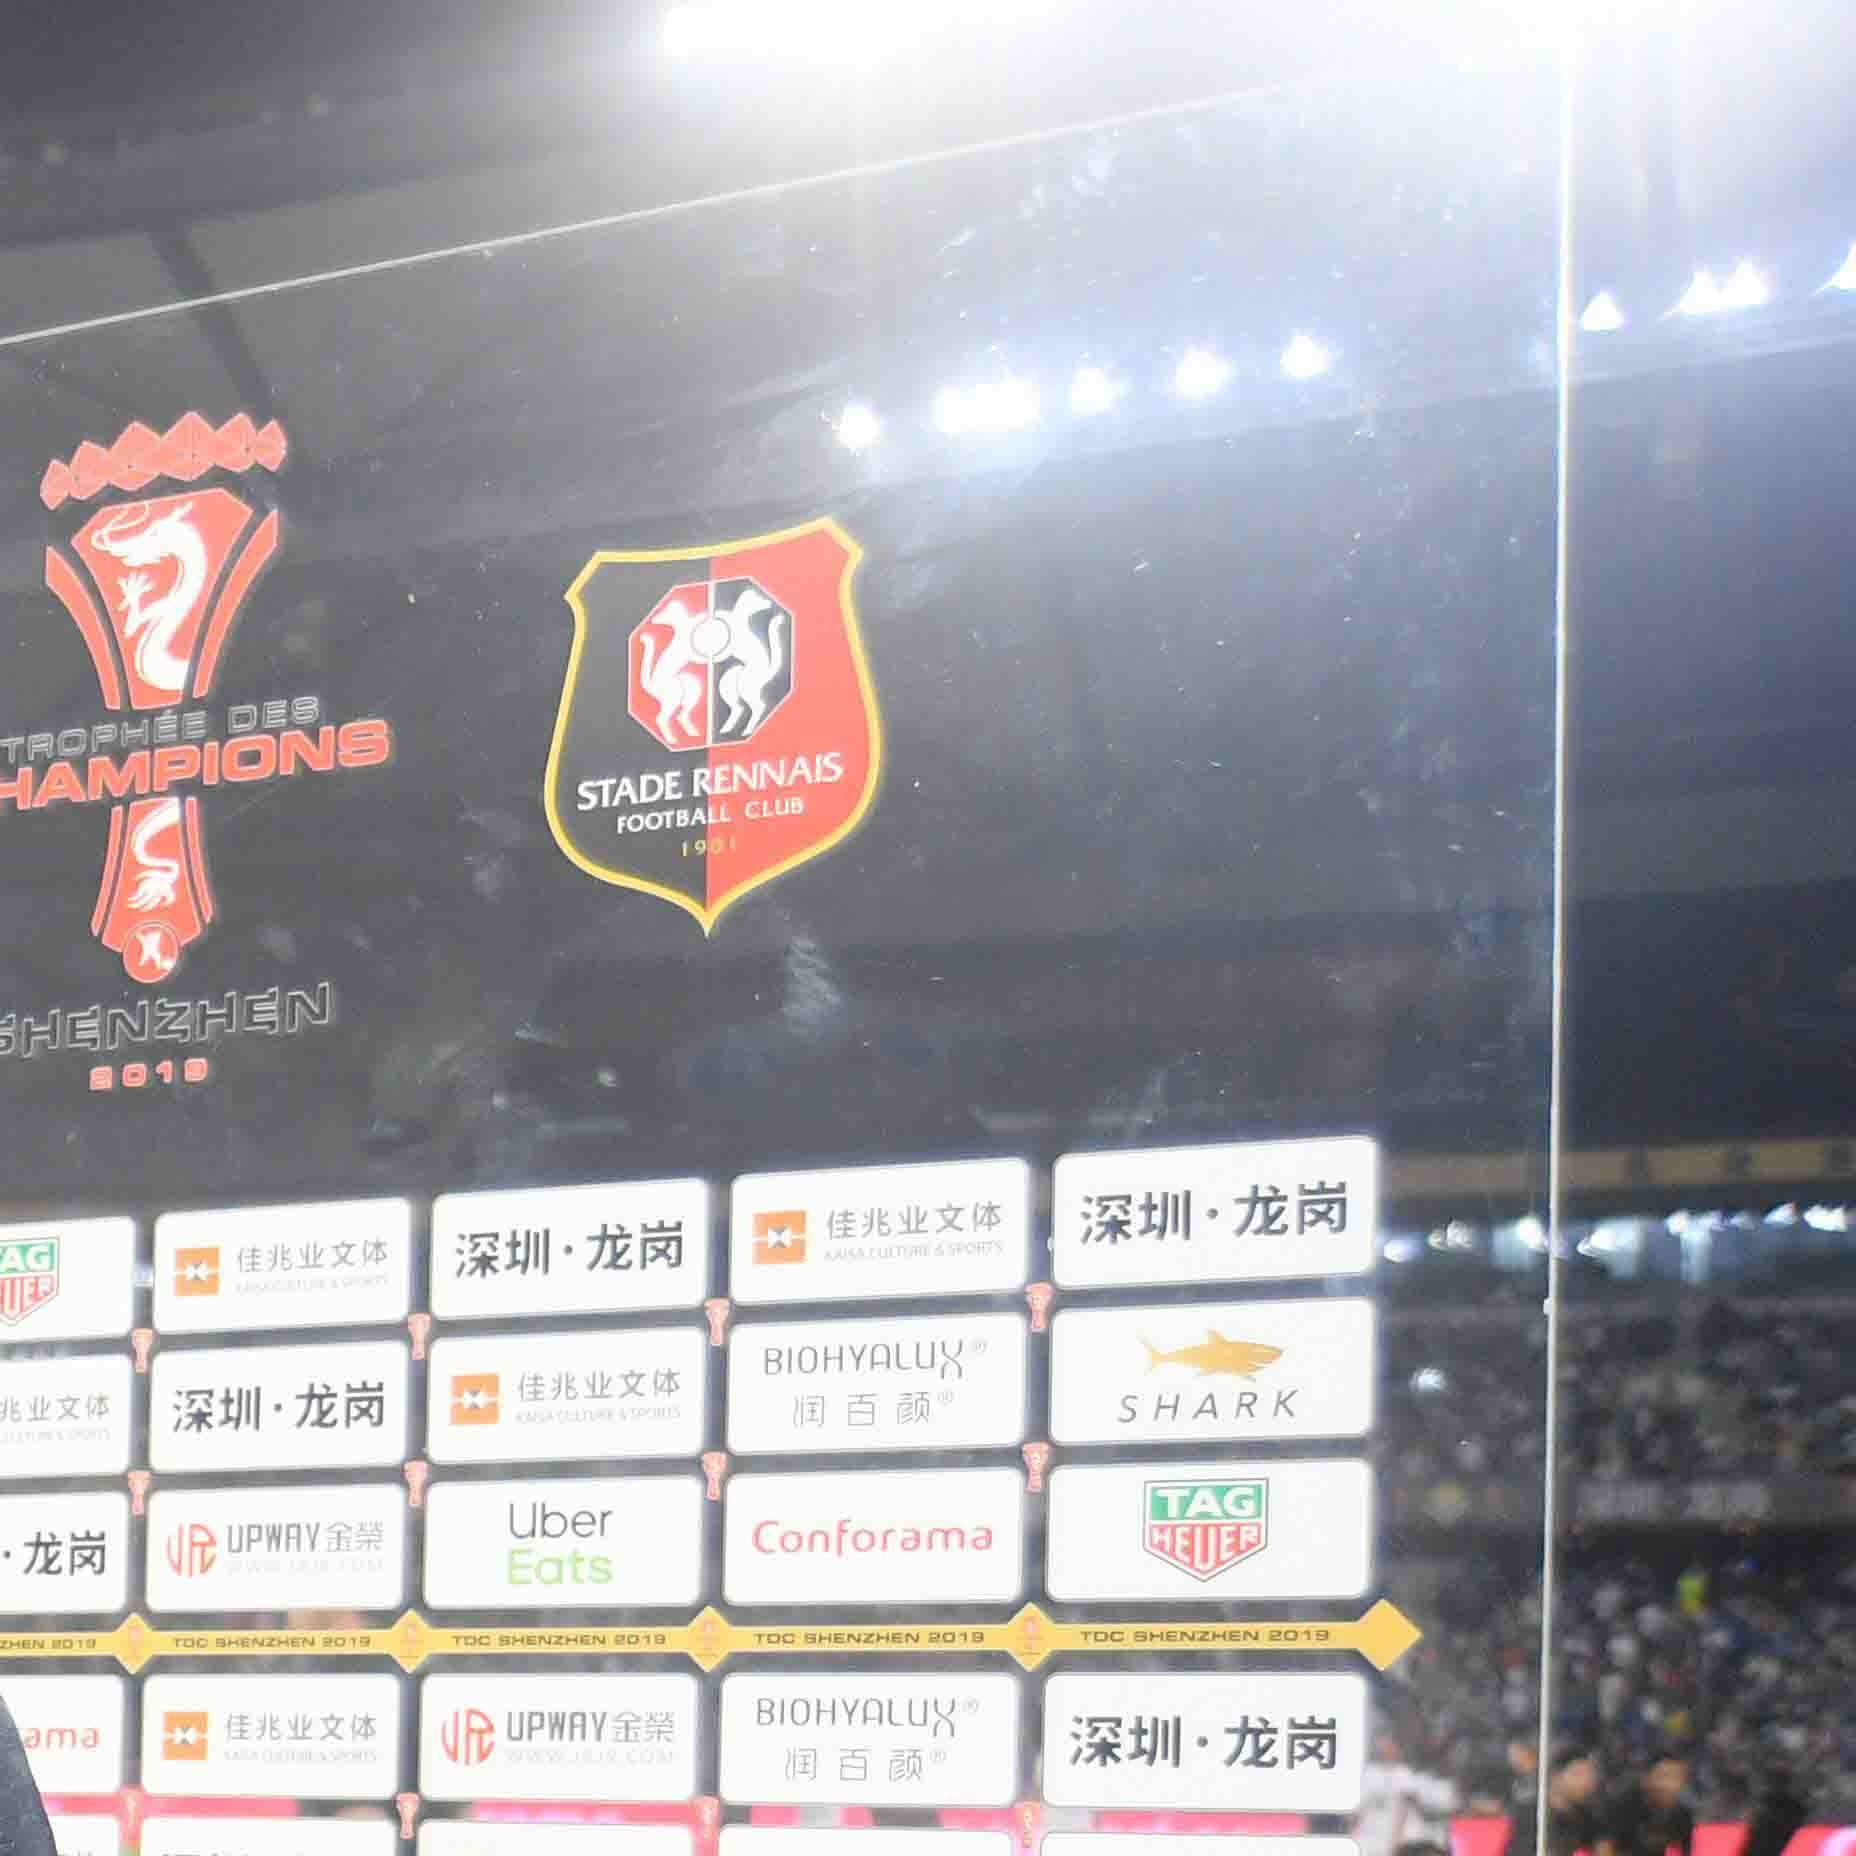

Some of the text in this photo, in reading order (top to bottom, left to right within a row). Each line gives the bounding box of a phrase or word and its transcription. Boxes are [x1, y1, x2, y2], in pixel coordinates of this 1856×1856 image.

[227, 696, 320, 735] DES
[577, 751, 843, 811] STADE RENNAIS
[616, 797, 804, 834] FOOTBALL CLUB
[89, 1057, 208, 1091] 2019
[827, 1204, 1000, 1239] 佳兆业文体
[518, 1368, 680, 1401] 佳兆业文体
[1118, 1390, 1298, 1423] SHARK
[1156, 1487, 1256, 1517] TAG
[510, 1502, 613, 1539] Uber
[752, 1519, 992, 1557] Conforama
[1150, 1525, 1259, 1575] HEUER
[507, 1548, 614, 1585] Eats
[174, 1637, 370, 1649] TDC SHENZHEN 2019
[453, 1633, 666, 1648] TDC SHENZHEN 2019
[755, 1631, 984, 1645] TDC SHENZHEN 2019
[1081, 1629, 1330, 1643] TDC SHENZHEN 2019
[226, 1712, 376, 1744] 佳兆业文体
